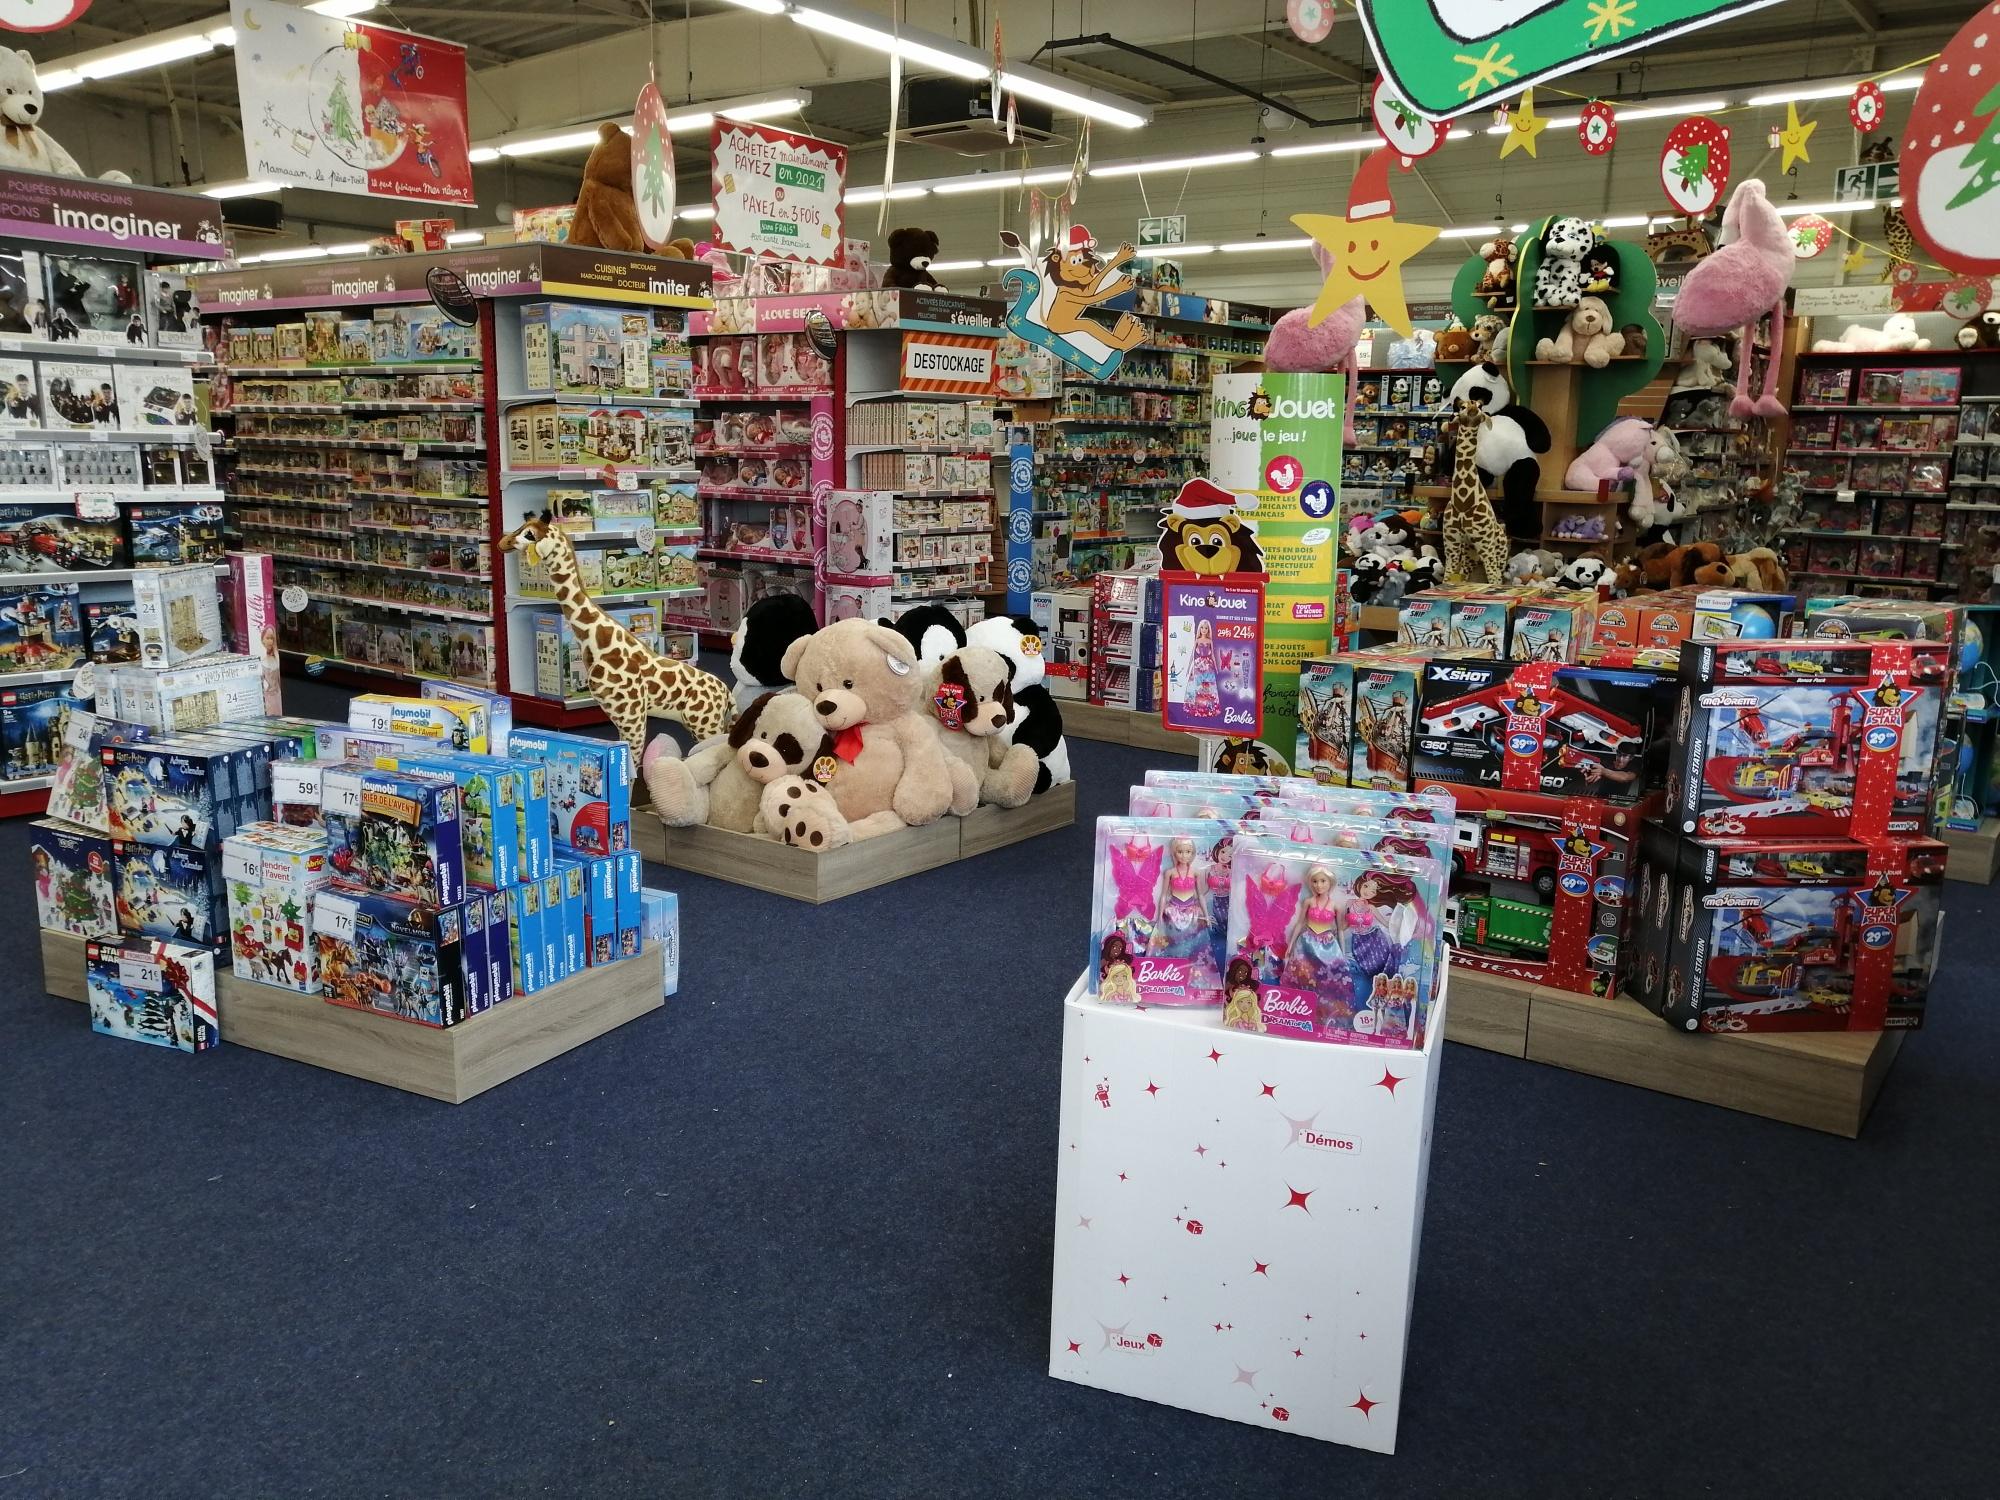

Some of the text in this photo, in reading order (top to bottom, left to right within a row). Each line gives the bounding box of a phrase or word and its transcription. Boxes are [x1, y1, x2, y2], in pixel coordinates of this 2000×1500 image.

[729, 134, 829, 170] ACHETEZ maintenant
[735, 154, 771, 178] PAYEZ
[779, 167, 792, 181] en
[8, 180, 133, 207] POUPÉES MANNEQUINS
[775, 190, 784, 199] OU
[742, 192, 776, 218] PAYEZ
[778, 208, 789, 219] en
[791, 205, 798, 222] 3
[53, 203, 182, 241] imaginer
[594, 262, 657, 276] CUISINES BRICOLAGE
[465, 268, 521, 289] imaginer
[618, 279, 646, 290] DOCTEUR
[331, 278, 378, 299] imaginer
[649, 277, 690, 298] imiter
[218, 287, 259, 306] imaginer
[764, 308, 791, 320] LOVE
[951, 311, 993, 328] s'éveiller
[913, 351, 985, 374] DESTOCKAGE
[1269, 395, 1335, 420] Jouet
[1263, 430, 1275, 442] le
[1278, 430, 1299, 444] jeu
[1302, 431, 1307, 442] !
[1246, 511, 1285, 519] FRANÇAIS
[143, 603, 156, 614] 24
[1180, 593, 1247, 609] King Jouet
[1409, 602, 1432, 612] PIRATE
[1410, 610, 1426, 618] SHIP
[1462, 606, 1486, 615] PIRATE
[1463, 614, 1480, 622] SHIP
[1526, 611, 1552, 621] PIRATE
[1527, 620, 1543, 628] SHIP
[1311, 664, 1334, 675] PIRATE
[1369, 673, 1394, 683] PIRATE
[1369, 682, 1386, 690] SHIP
[226, 693, 239, 704] 24
[1263, 683, 1299, 702] frança
[391, 706, 431, 719] laymobil
[1224, 707, 1255, 725] Barbie
[1278, 701, 1299, 717] côt
[1868, 707, 1901, 717] SUPER
[391, 722, 408, 732] ndrier
[1511, 715, 1540, 724] SUPER
[1513, 723, 1537, 731] STAR
[1871, 716, 1898, 726] STAR
[509, 737, 547, 751] playmobil
[179, 766, 205, 776] Calendar
[620, 748, 628, 786] playmobil
[1480, 769, 1503, 781] LA
[362, 780, 398, 795] laymobil
[379, 795, 388, 806] DE
[388, 796, 415, 815] L'AVENT
[262, 860, 291, 872] lendrier
[498, 845, 506, 886] playmobil
[530, 838, 538, 879] playmobil
[1562, 855, 1593, 865] SUPER
[265, 870, 290, 881] l'avent
[630, 856, 639, 893] playmobil
[1565, 863, 1588, 872] STAR
[439, 862, 450, 905] playmobil
[604, 861, 613, 899] playmobil
[1864, 906, 1897, 916] SUPER
[1867, 915, 1894, 924] STAR
[390, 922, 431, 938] NOVELMORE
[567, 933, 575, 972] playmobil
[547, 944, 555, 983] playmobil
[1137, 960, 1185, 983] Barbie
[1449, 955, 1544, 981] CK TEAM
[525, 953, 533, 992] playmobil
[491, 962, 499, 1002] playmobil
[469, 972, 478, 1013] playmobil
[1136, 984, 1185, 997] DREAMTOPIA
[443, 983, 452, 1026] playmobil
[1263, 989, 1313, 1016] Barbie
[1261, 1013, 1313, 1032] DREAMTOPIA
[1305, 1131, 1354, 1150] Démos
[1116, 1335, 1145, 1351] Jeux
